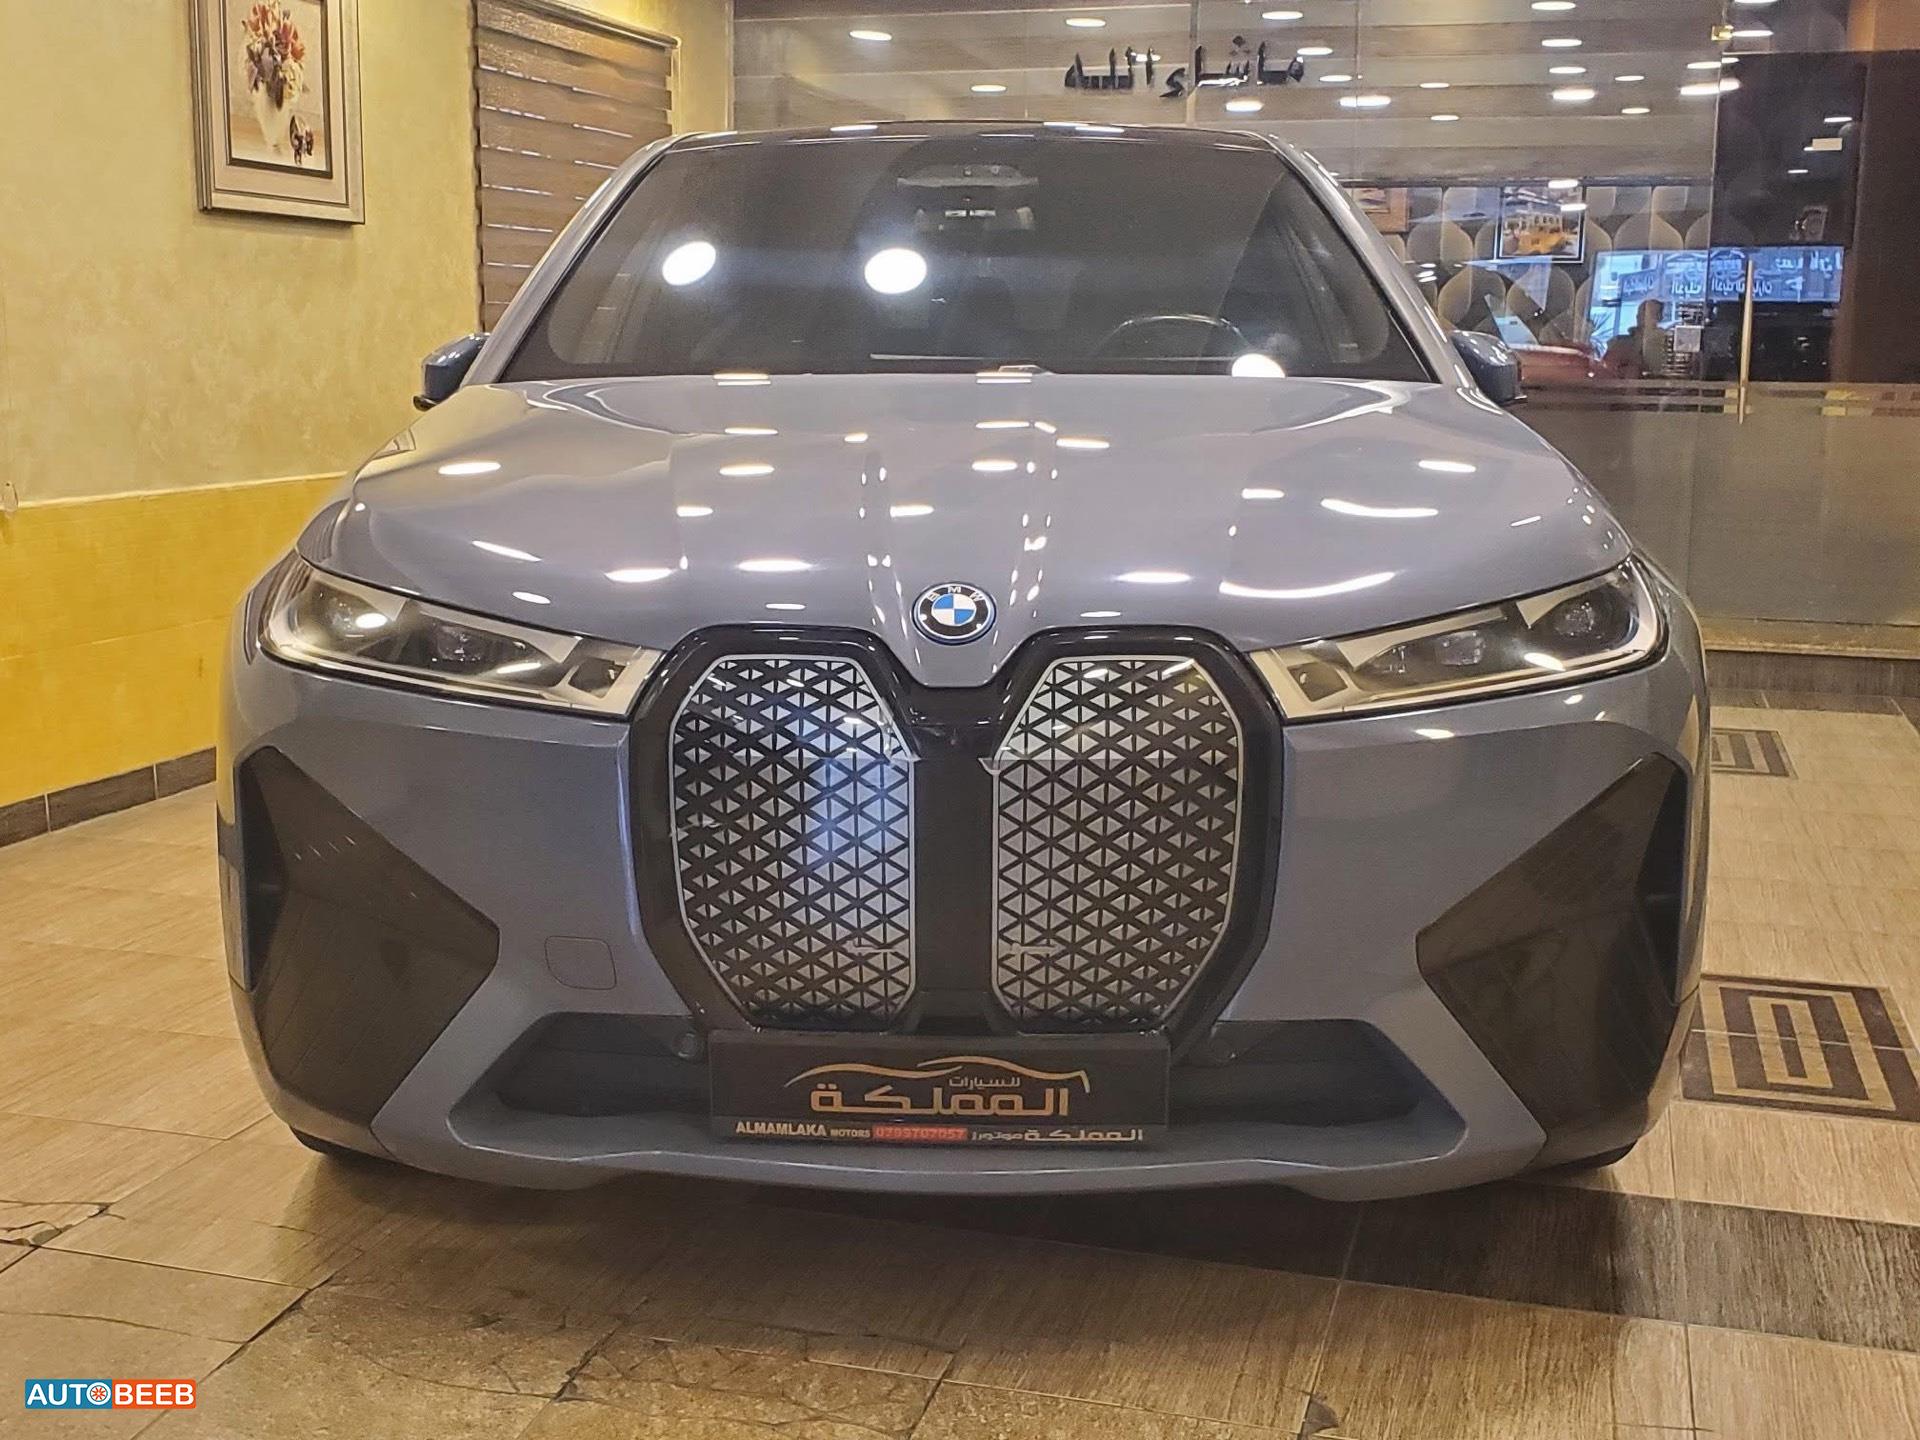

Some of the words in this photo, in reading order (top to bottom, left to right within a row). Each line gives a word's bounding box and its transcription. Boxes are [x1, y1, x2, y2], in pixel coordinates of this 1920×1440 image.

[927, 586, 983, 602] BMW
[948, 1075, 1021, 1090] للسيارات
[810, 1083, 1069, 1116] المملكة
[736, 1121, 826, 1137] ALMAMLAKA
[830, 1128, 871, 1138] MOTORS
[971, 1130, 1024, 1141] موتورز
[1024, 1128, 1143, 1142] المملكة
